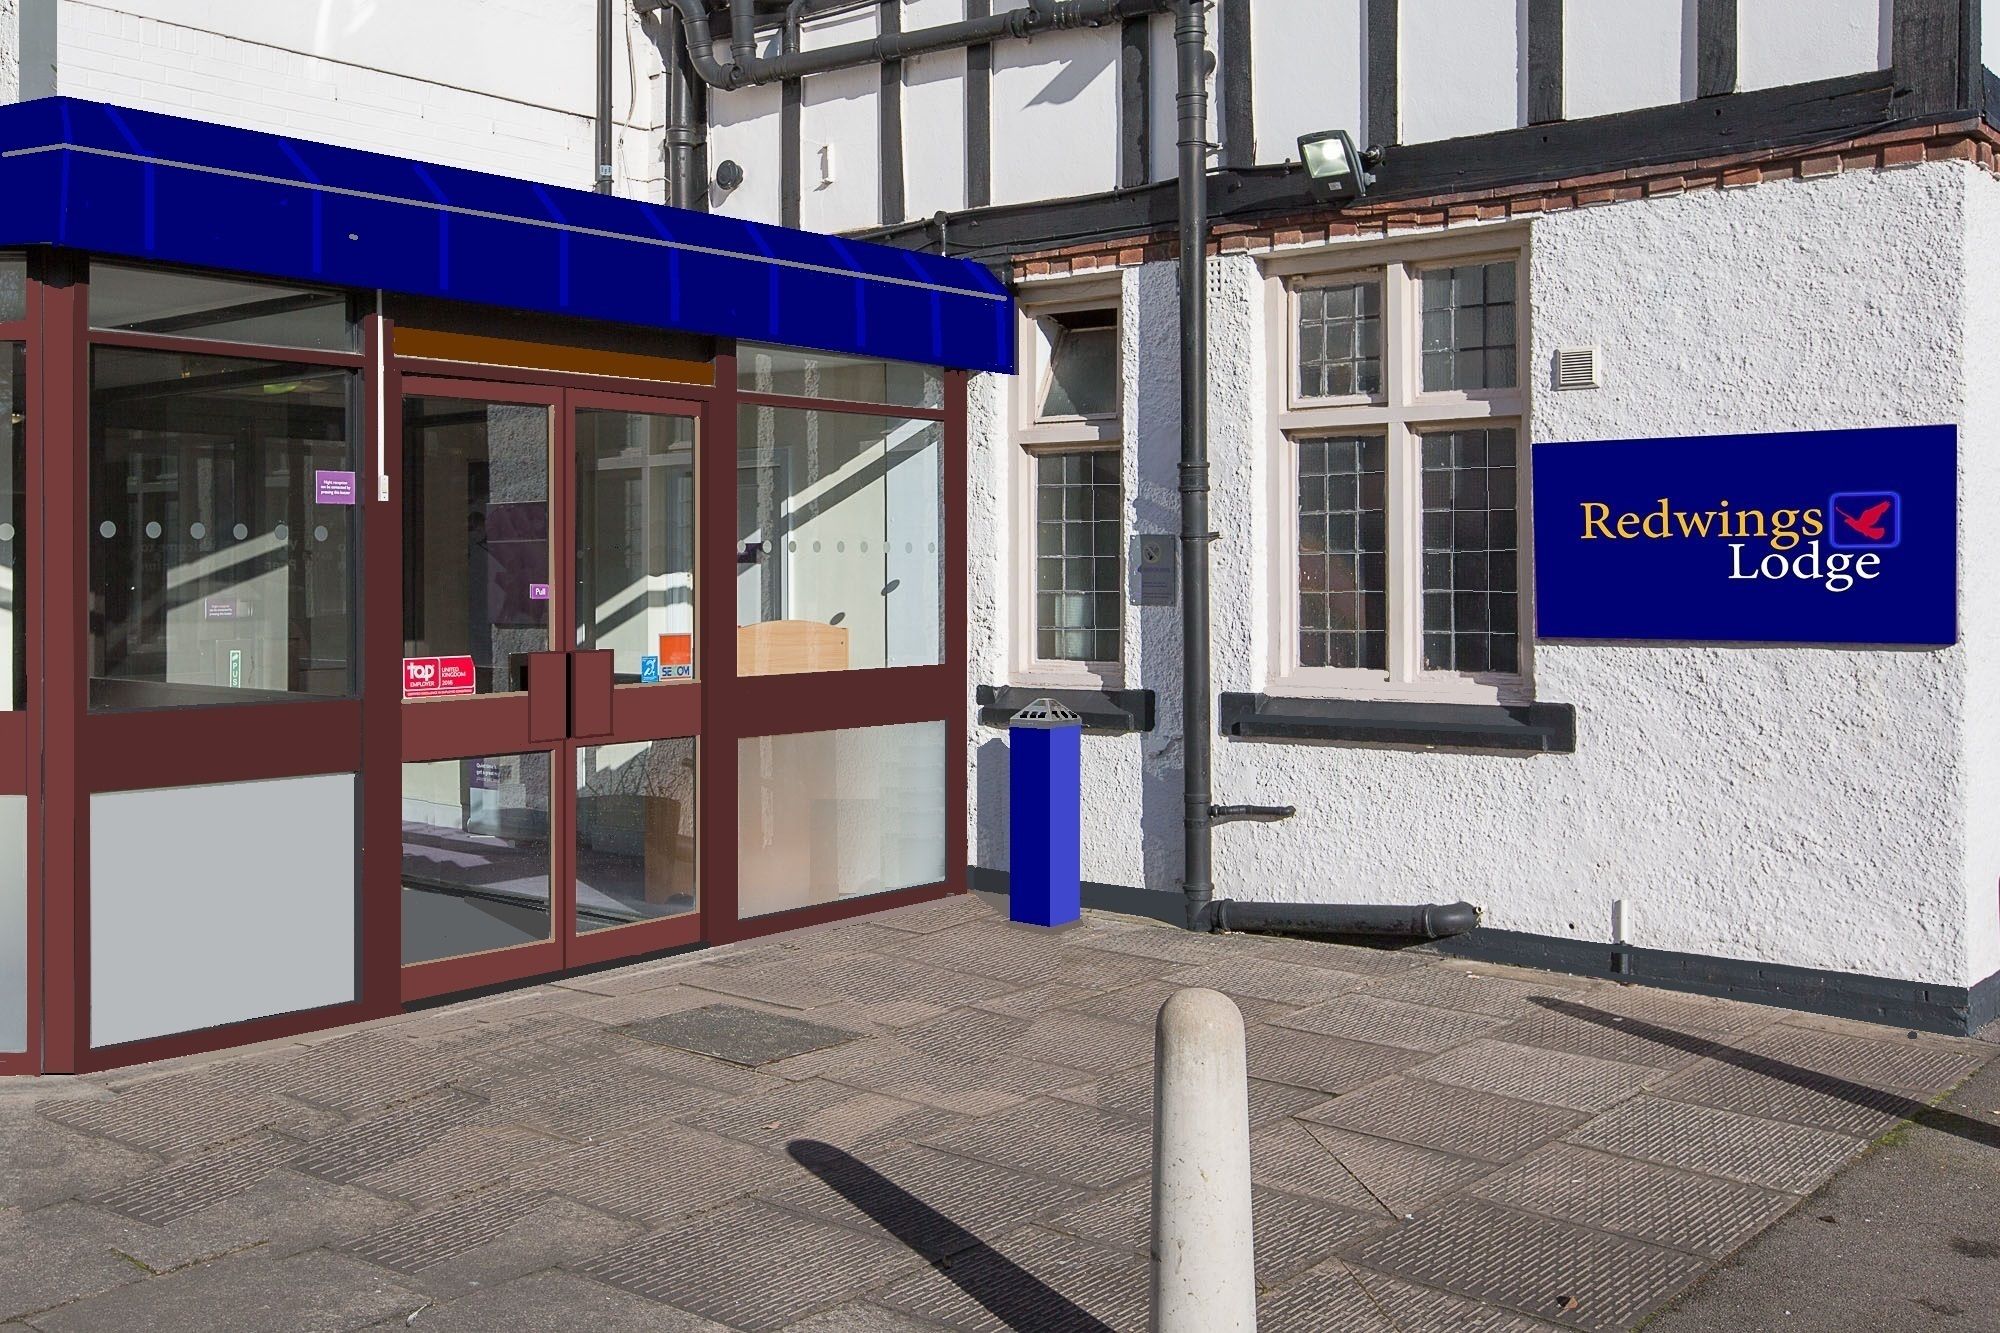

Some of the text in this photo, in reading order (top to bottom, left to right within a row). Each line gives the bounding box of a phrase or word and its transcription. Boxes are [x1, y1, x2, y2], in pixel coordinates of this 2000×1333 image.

[1580, 497, 1824, 550] Redwings
[1728, 540, 1881, 592] Lodge
[535, 587, 546, 596] Pull
[406, 662, 435, 681] top
[662, 666, 690, 677] SEOM
